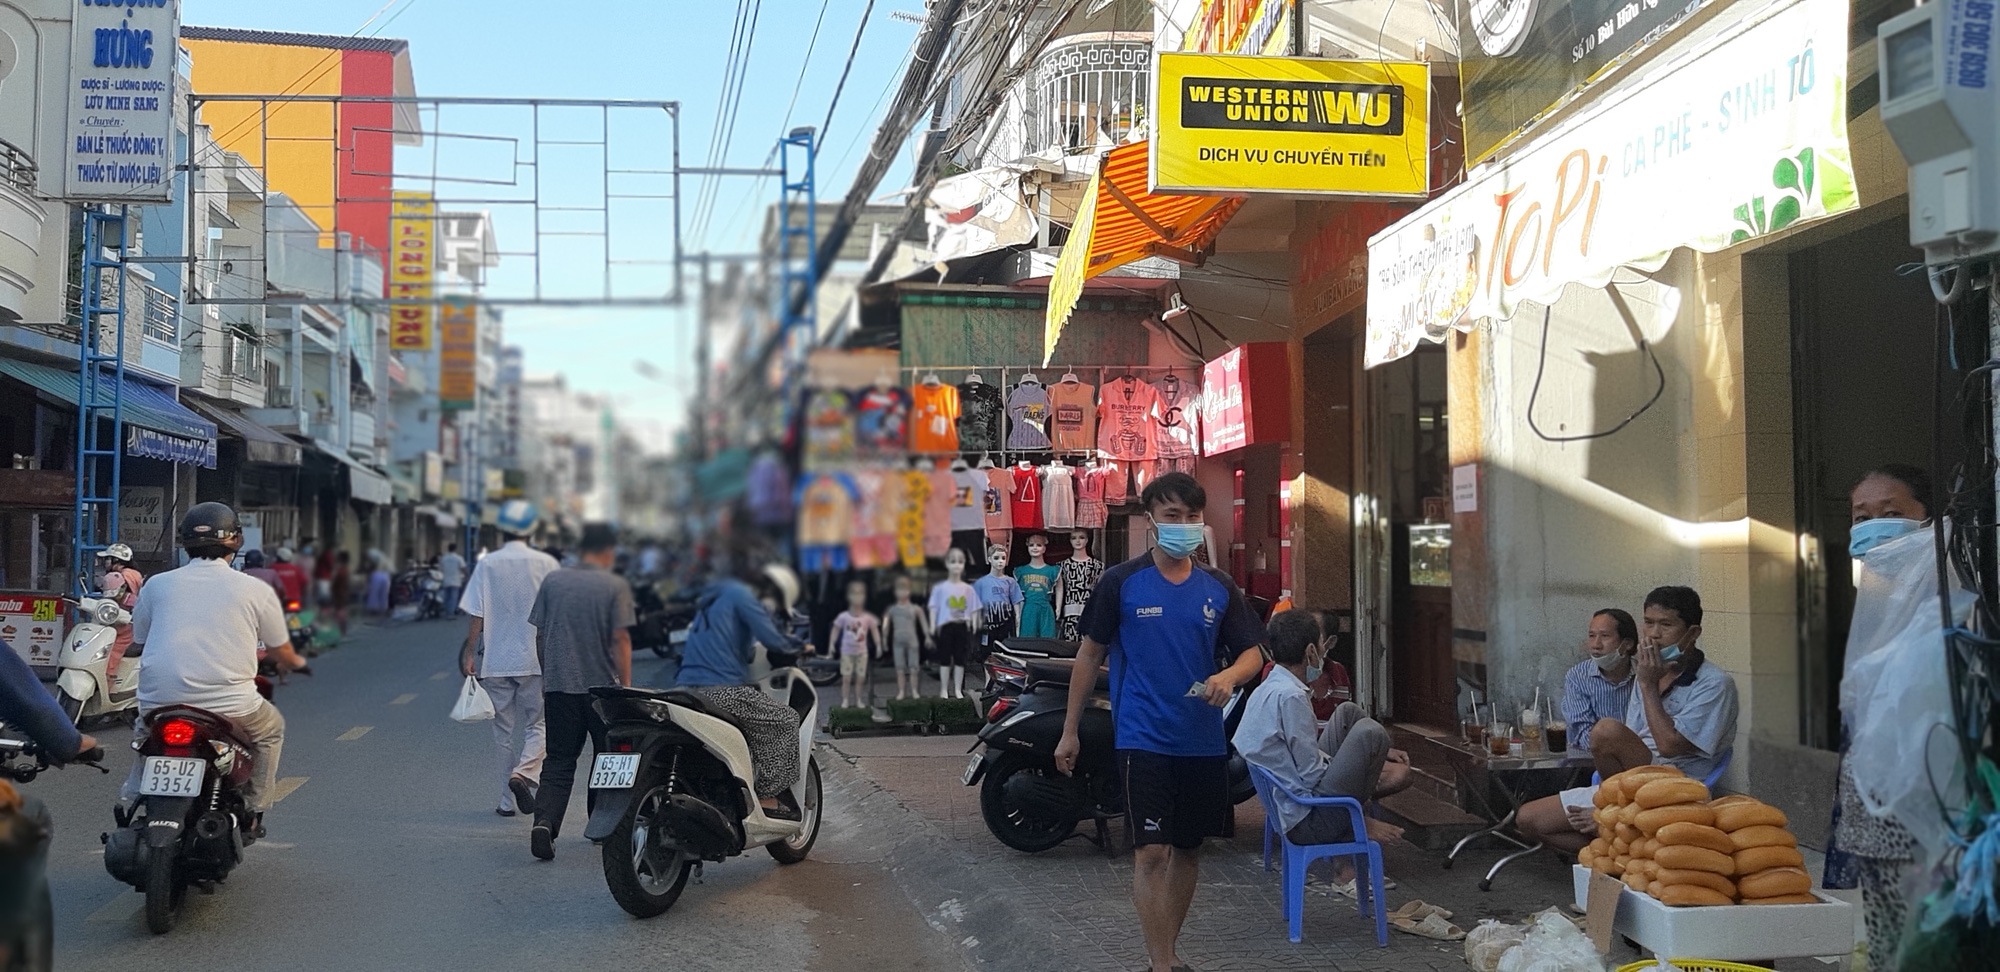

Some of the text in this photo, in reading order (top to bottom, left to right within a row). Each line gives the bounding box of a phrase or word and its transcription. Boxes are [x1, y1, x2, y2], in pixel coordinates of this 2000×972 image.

[1572, 37, 1585, 63] Số
[1585, 34, 1595, 55] 10
[1598, 19, 1614, 45] Bùi
[81, 77, 101, 93] DƯỢC
[115, 78, 140, 91] LƯƠNG
[105, 96, 130, 110] MINH
[133, 97, 159, 111] SANG
[1188, 86, 1308, 106] WESTERN
[1226, 105, 1308, 123] UNION
[1321, 90, 1392, 127] WU
[1653, 102, 1692, 163] PHÊ
[1718, 68, 1776, 133] SINH
[76, 131, 93, 153] BÁN
[106, 129, 132, 154] THUỐC
[133, 132, 156, 155] ĐÔNG
[1199, 147, 1238, 164] DỊCH
[1244, 149, 1268, 166] VỤ
[1273, 146, 1343, 166] CHUYỂN
[77, 158, 105, 183] THUỐC
[119, 162, 142, 188] DƯỢC
[398, 225, 426, 275] LONG
[32, 600, 57, 621] 25K
[1136, 606, 1163, 615] FUN88
[153, 760, 196, 776] 65-U2
[601, 756, 633, 770] 65-H1
[150, 777, 192, 793] 3354
[593, 771, 634, 786] 337.02
